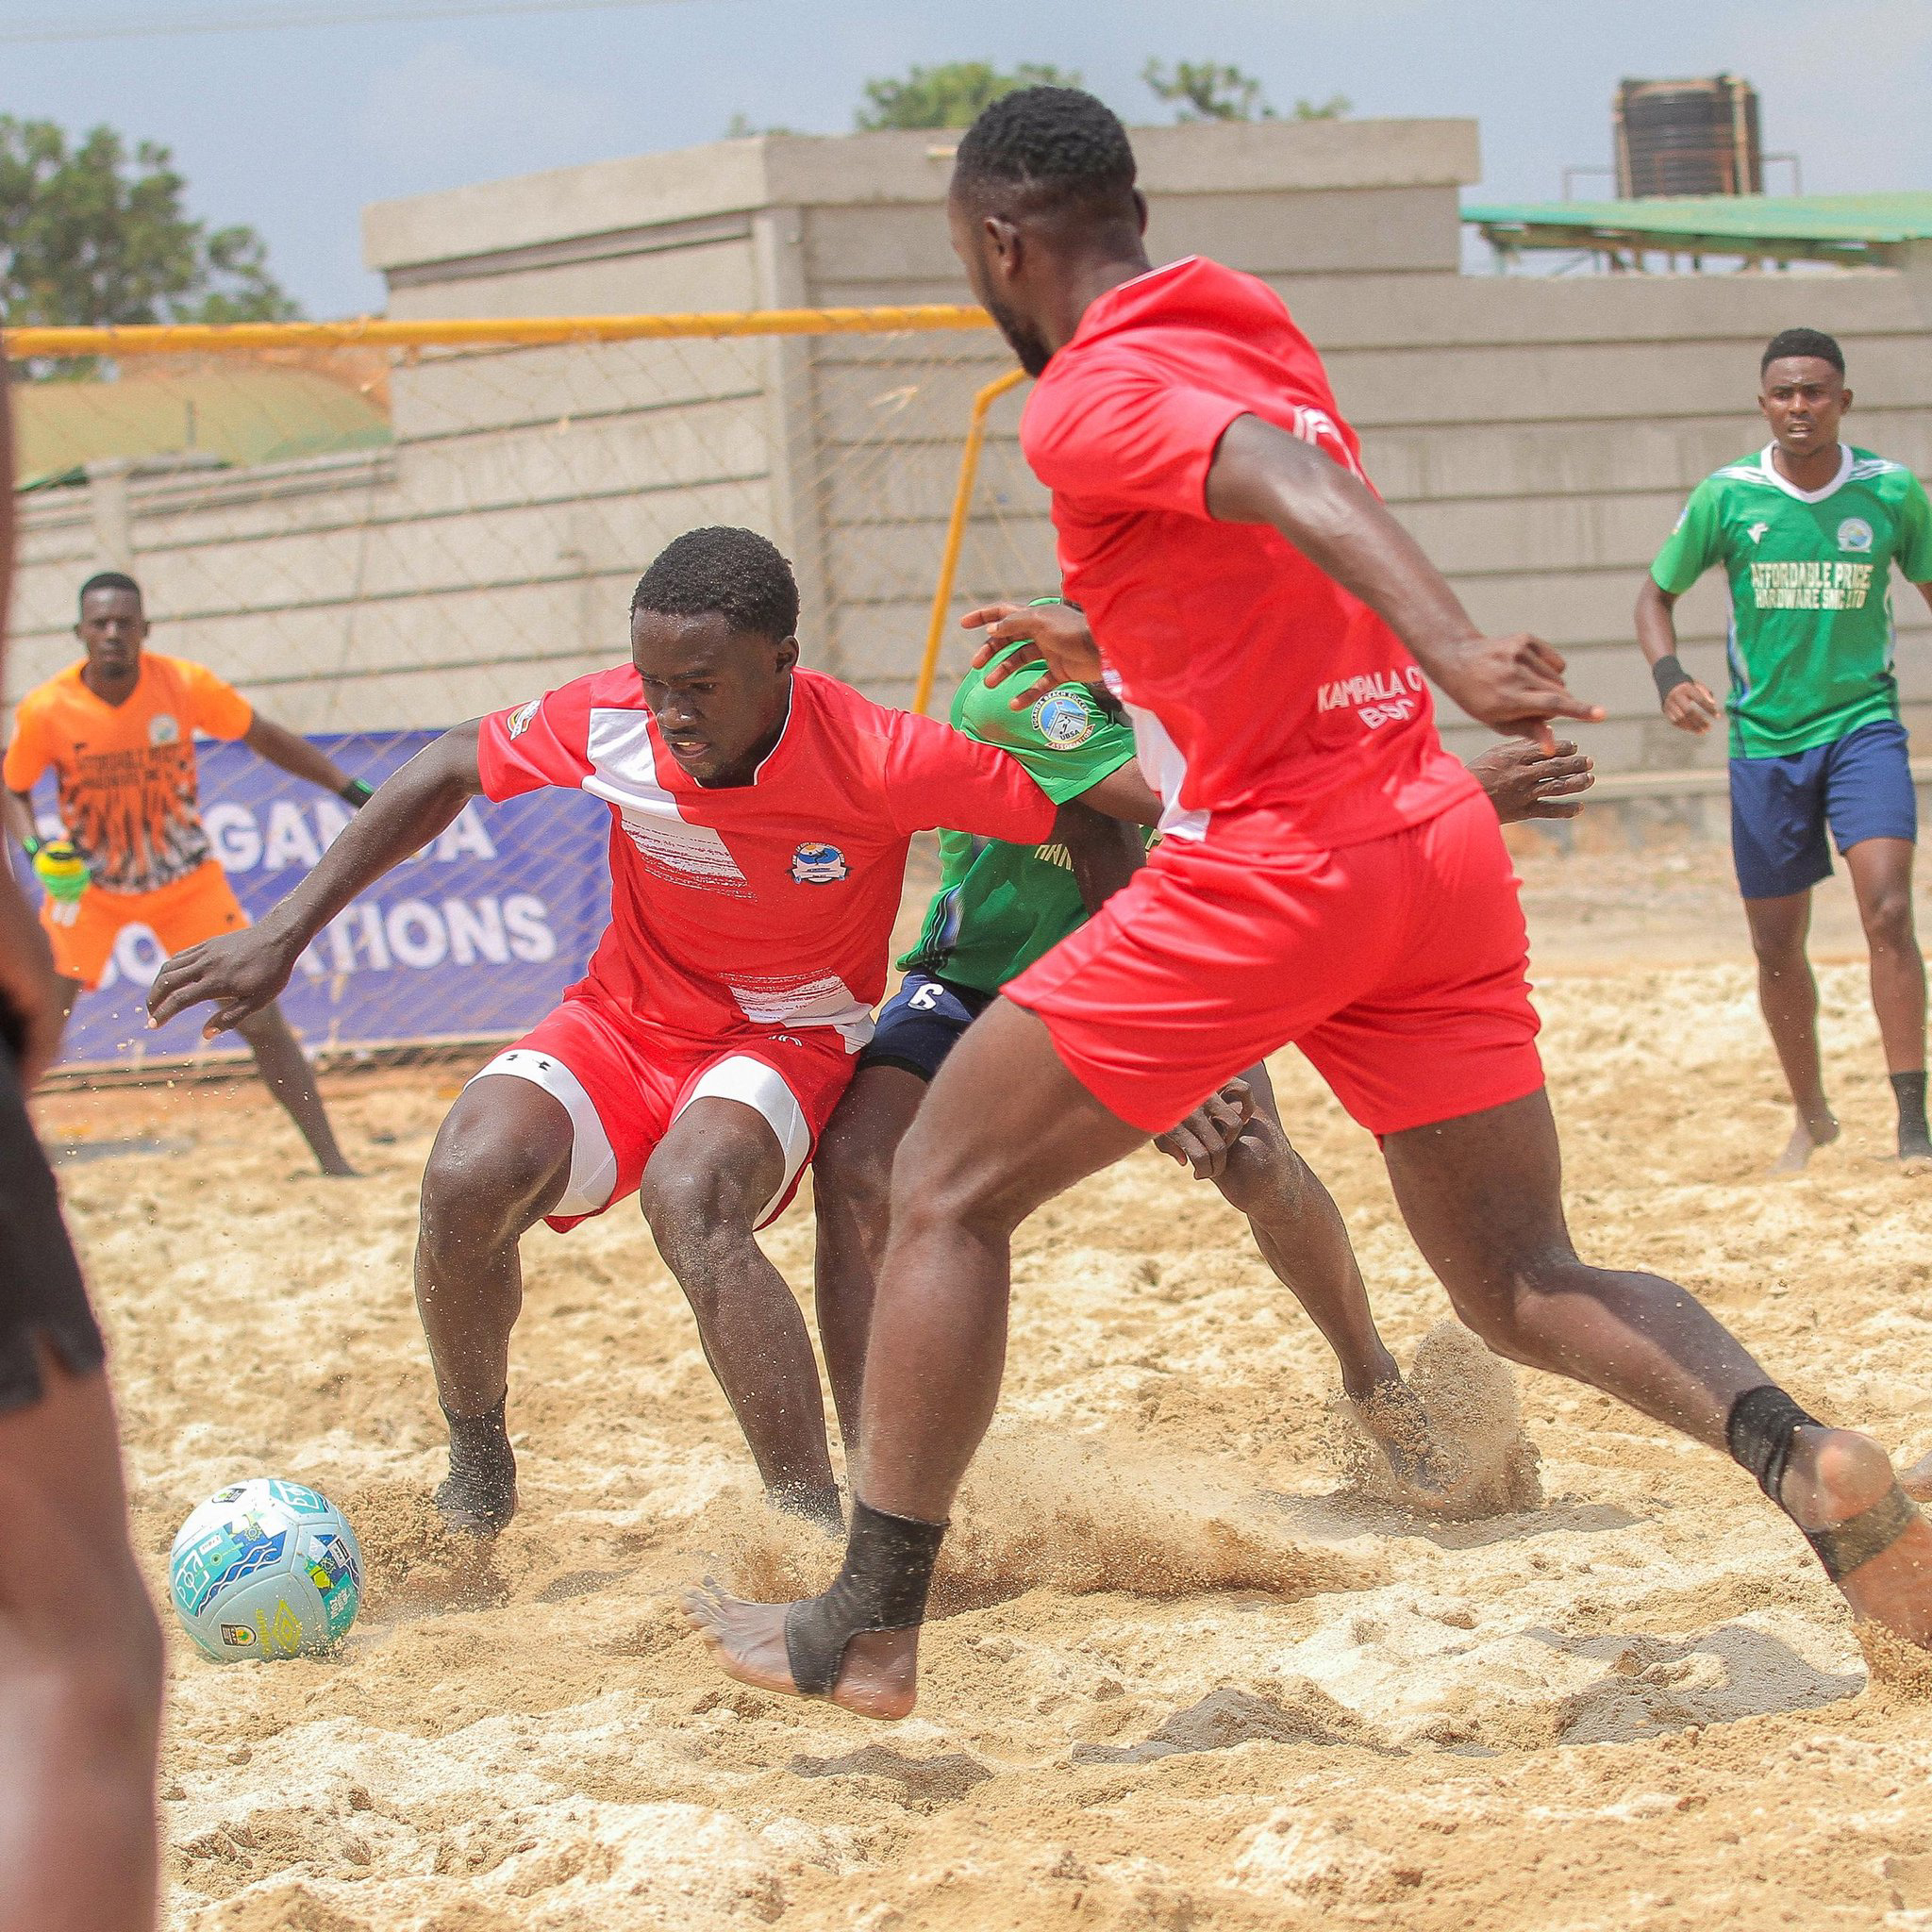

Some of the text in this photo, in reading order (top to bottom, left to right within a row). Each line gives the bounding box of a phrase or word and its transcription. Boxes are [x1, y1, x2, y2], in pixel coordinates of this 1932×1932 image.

[1751, 561, 1874, 589] AFFORDABLE PRICE
[1755, 588, 1820, 609] HARDWARE
[1317, 670, 1407, 713] KAMPALA
[1059, 729, 1080, 741] UBSA
[201, 790, 498, 874] GAA
[908, 983, 944, 1011] 6
